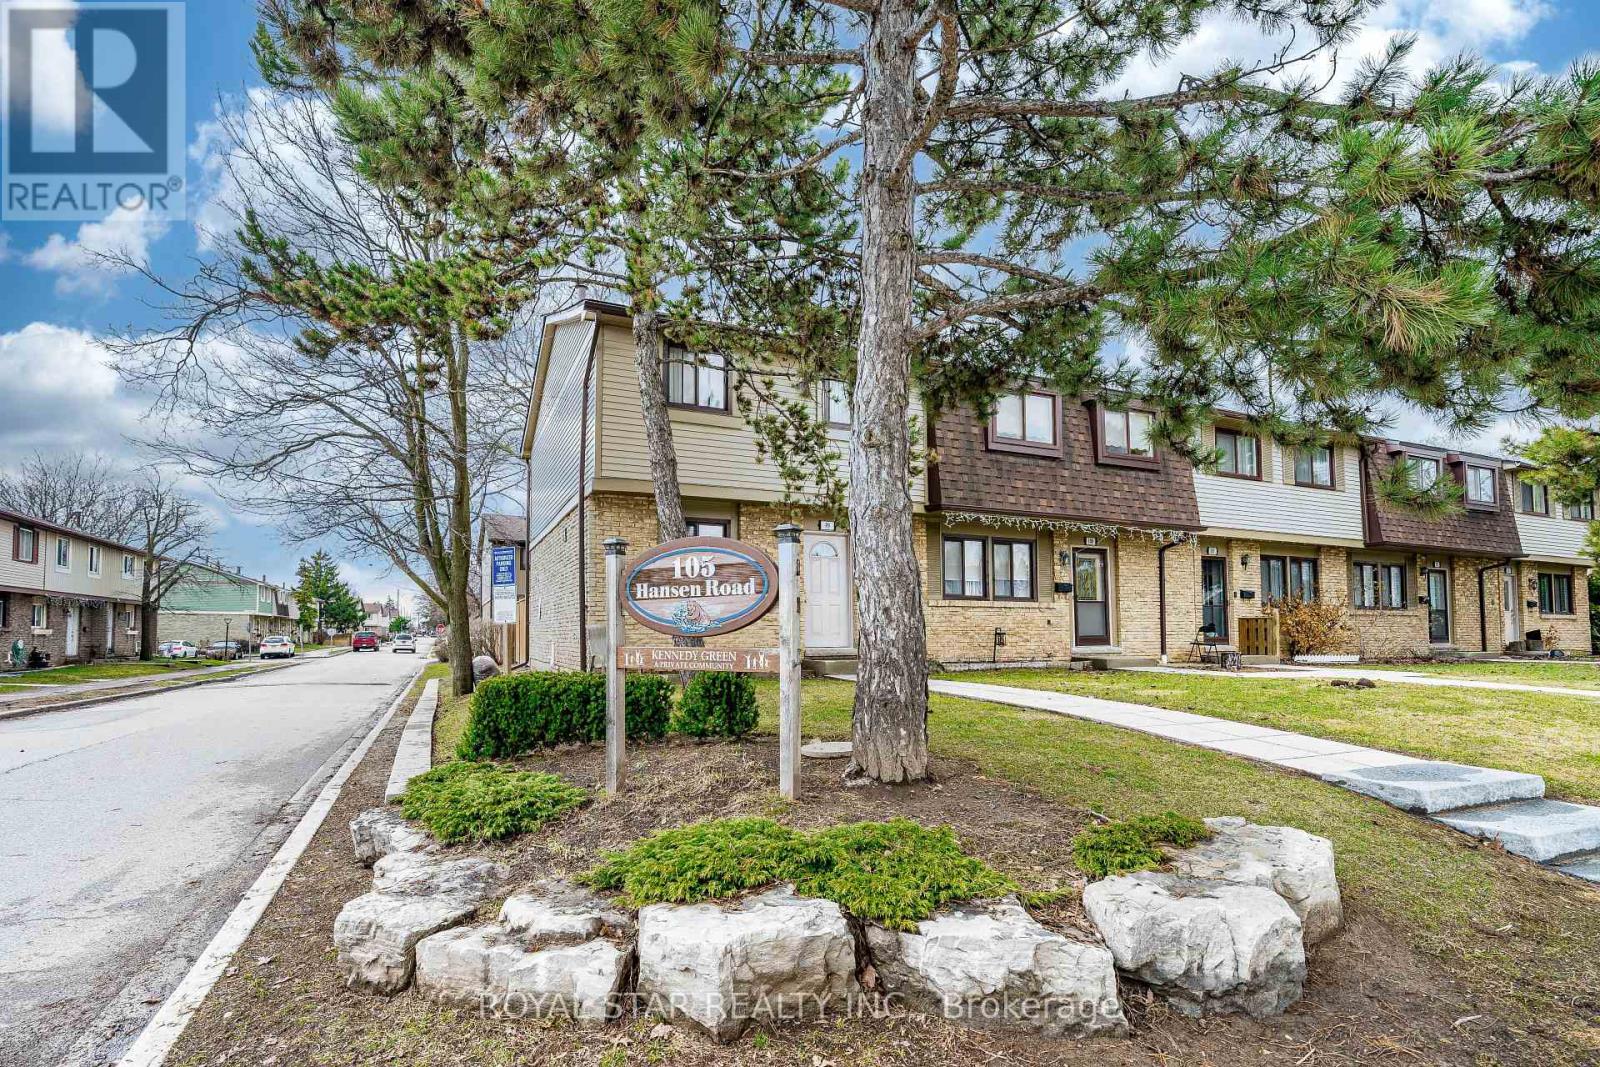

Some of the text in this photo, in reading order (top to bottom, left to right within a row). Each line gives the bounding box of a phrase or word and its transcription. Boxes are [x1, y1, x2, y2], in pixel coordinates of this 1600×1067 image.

[672, 555, 717, 579] 105
[636, 576, 757, 600] Hansen Road
[652, 650, 737, 662] KENNEDY GREEN
[659, 661, 688, 669] PRIVATE
[688, 661, 735, 670] COMMUNITY
